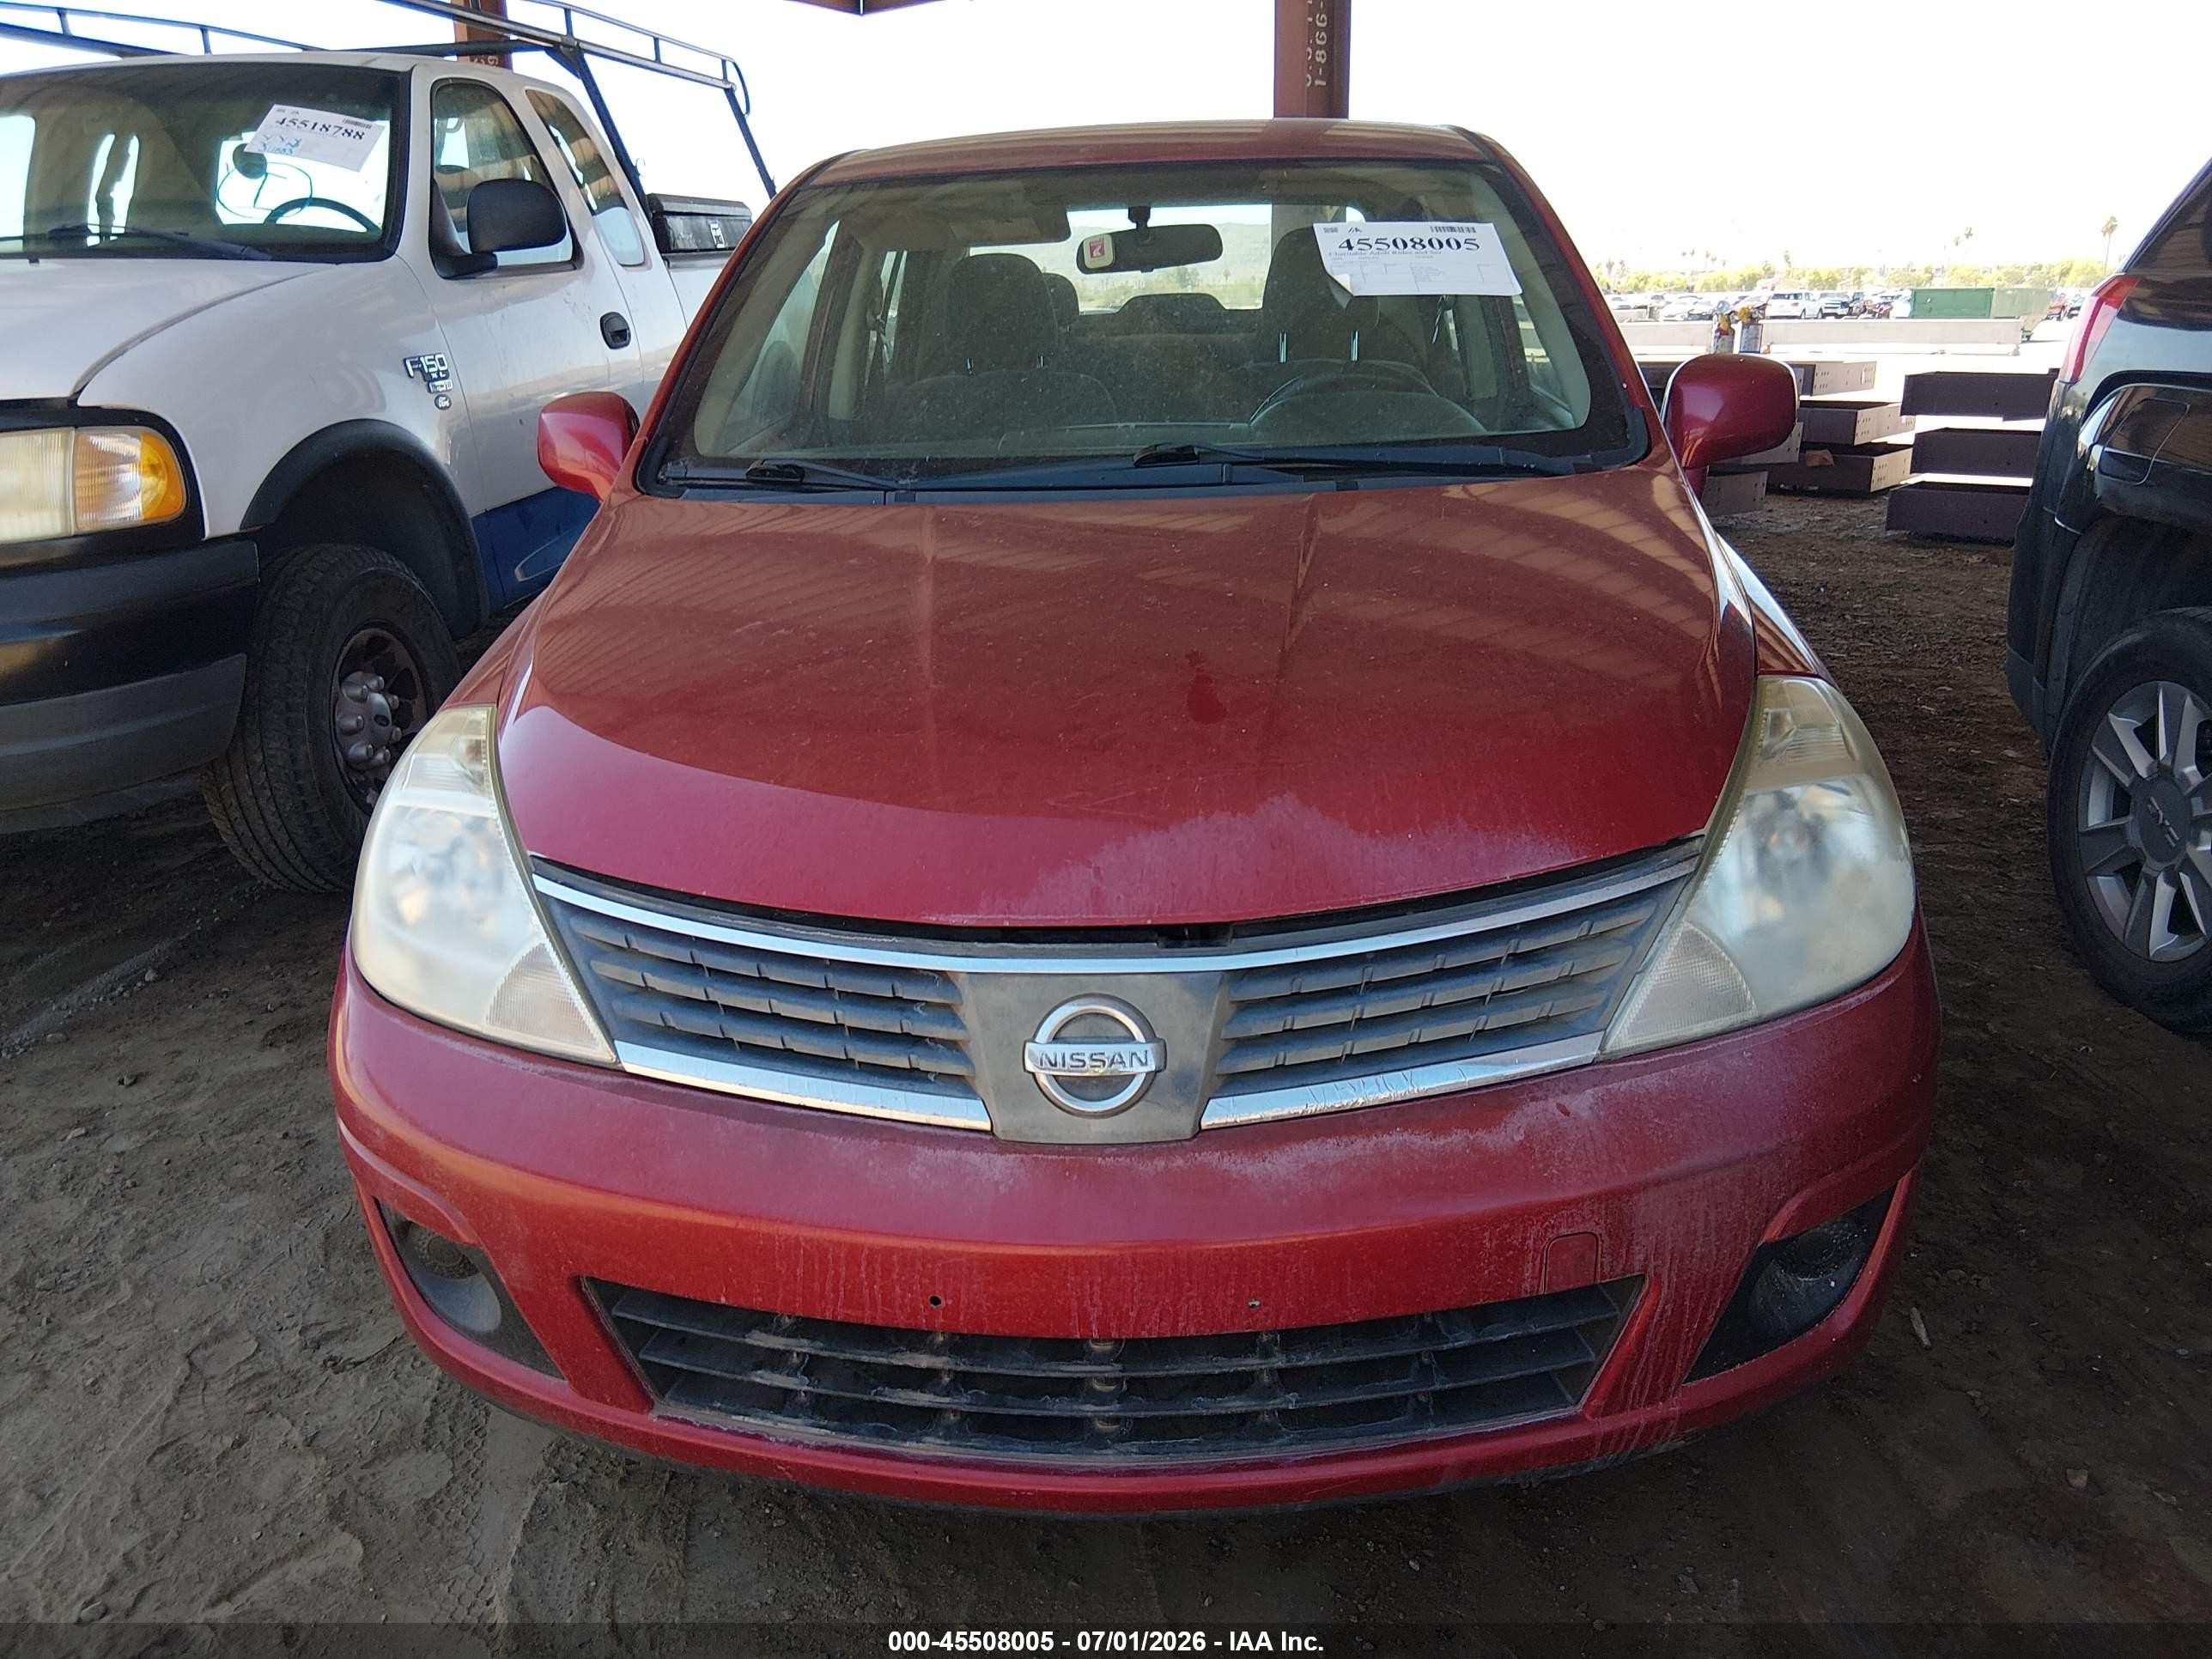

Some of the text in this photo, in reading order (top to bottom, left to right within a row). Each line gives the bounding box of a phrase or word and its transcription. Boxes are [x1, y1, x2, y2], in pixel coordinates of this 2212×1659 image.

[275, 117, 366, 141] 45518788
[1338, 237, 1480, 251] 45508005
[1038, 1050, 1149, 1068] NISSAN
